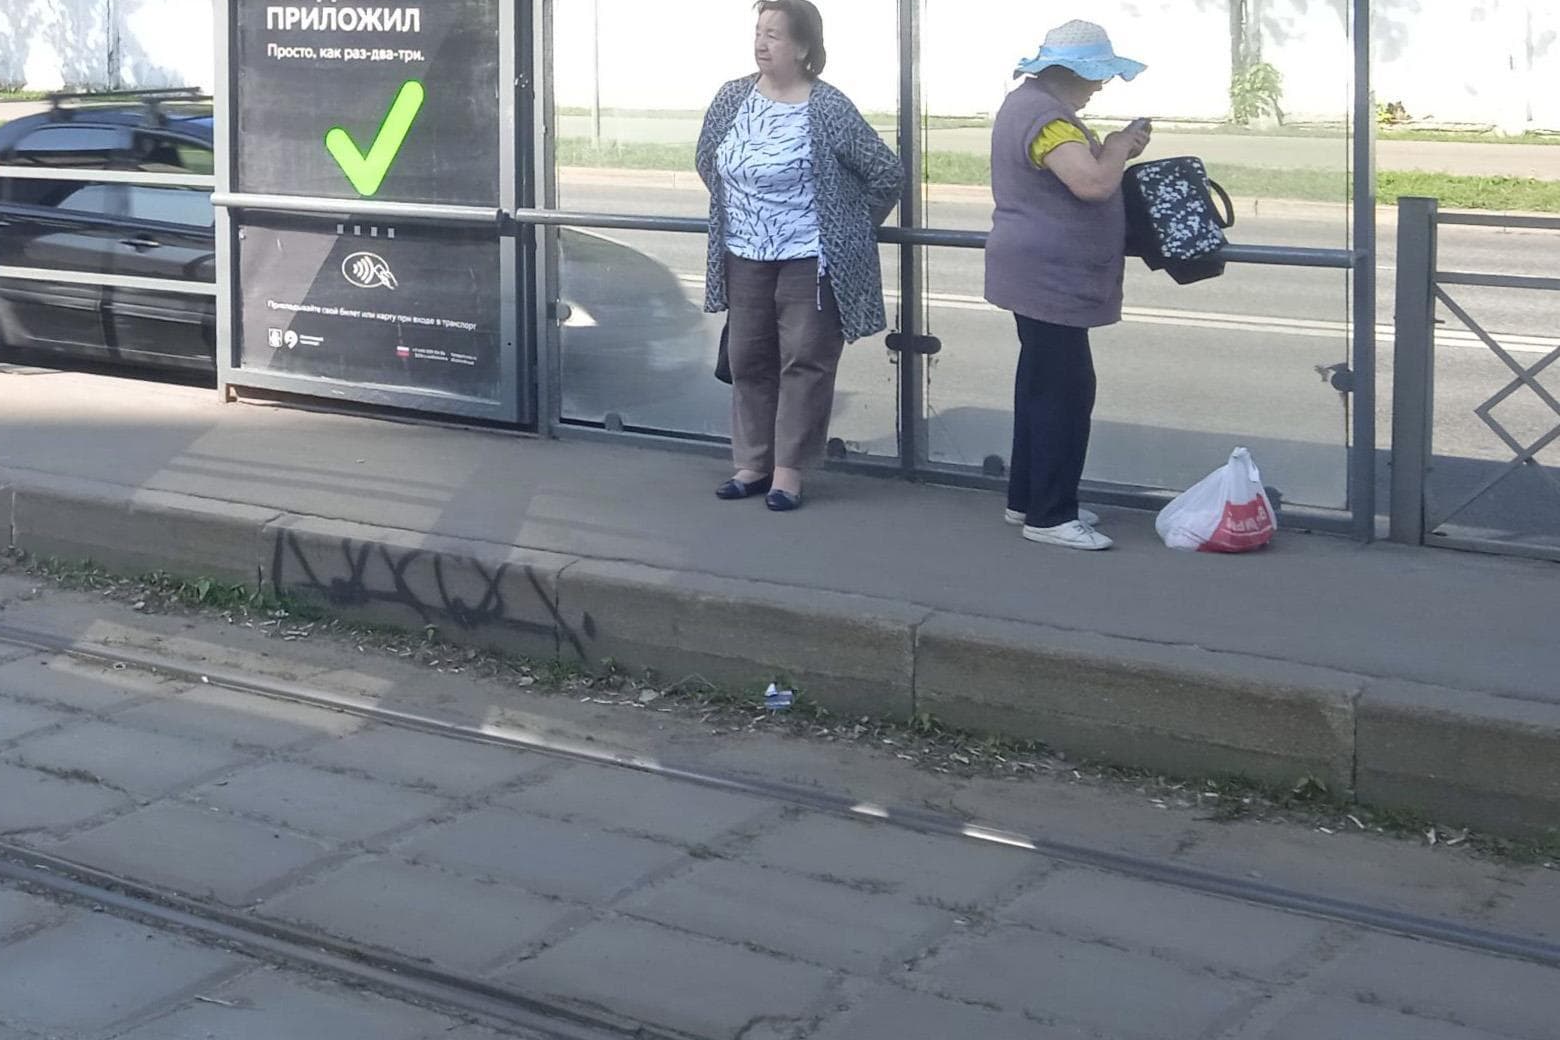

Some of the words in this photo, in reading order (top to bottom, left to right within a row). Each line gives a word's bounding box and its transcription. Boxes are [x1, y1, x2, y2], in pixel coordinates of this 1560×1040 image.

[266, 6, 421, 33] ПРИЛОЖИЛ
[319, 47, 342, 59] как
[344, 47, 425, 63] раз-два-три.
[376, 312, 397, 323] карту
[397, 314, 412, 323] при
[442, 319, 477, 331] транспорт
